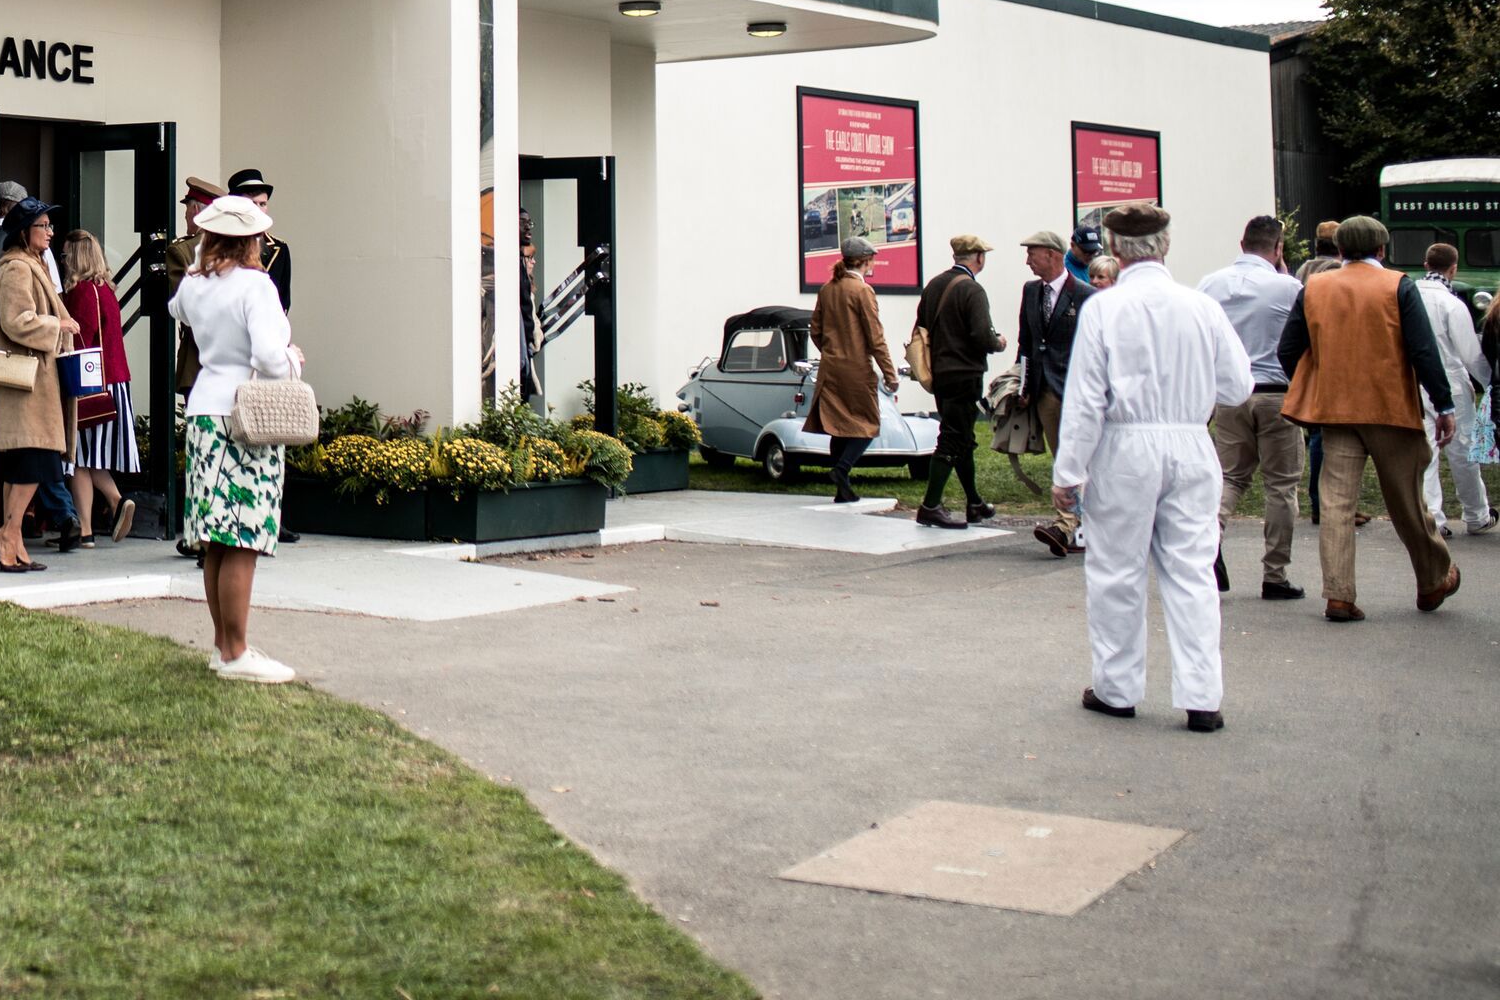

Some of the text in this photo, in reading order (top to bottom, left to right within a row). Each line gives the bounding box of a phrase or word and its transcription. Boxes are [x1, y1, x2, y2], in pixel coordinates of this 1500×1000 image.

[825, 129, 835, 150] THE
[835, 130, 850, 152] EARLS
[851, 132, 864, 153] COURT
[882, 135, 894, 156] SHOW
[1395, 202, 1423, 210] BEST
[1428, 202, 1479, 210] DRESSED
